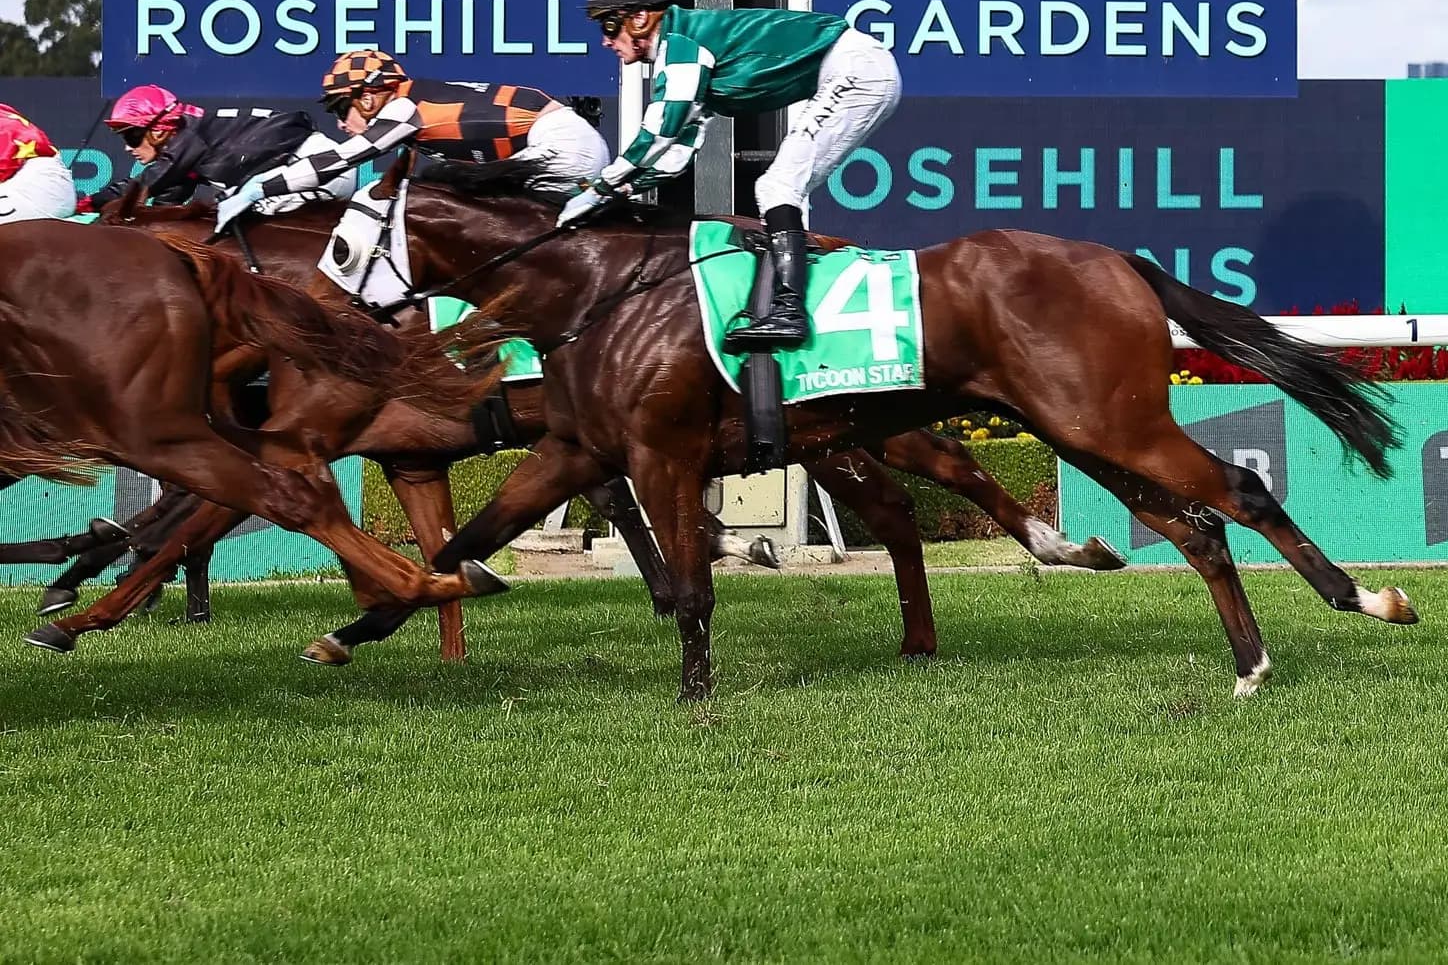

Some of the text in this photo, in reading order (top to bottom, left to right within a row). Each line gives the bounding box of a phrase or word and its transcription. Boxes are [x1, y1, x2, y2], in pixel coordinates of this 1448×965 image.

[845, 0, 1267, 57] GARDENS
[811, 147, 1264, 210] OSEHILL
[813, 259, 909, 361] 4
[795, 367, 866, 392] TYCOON
